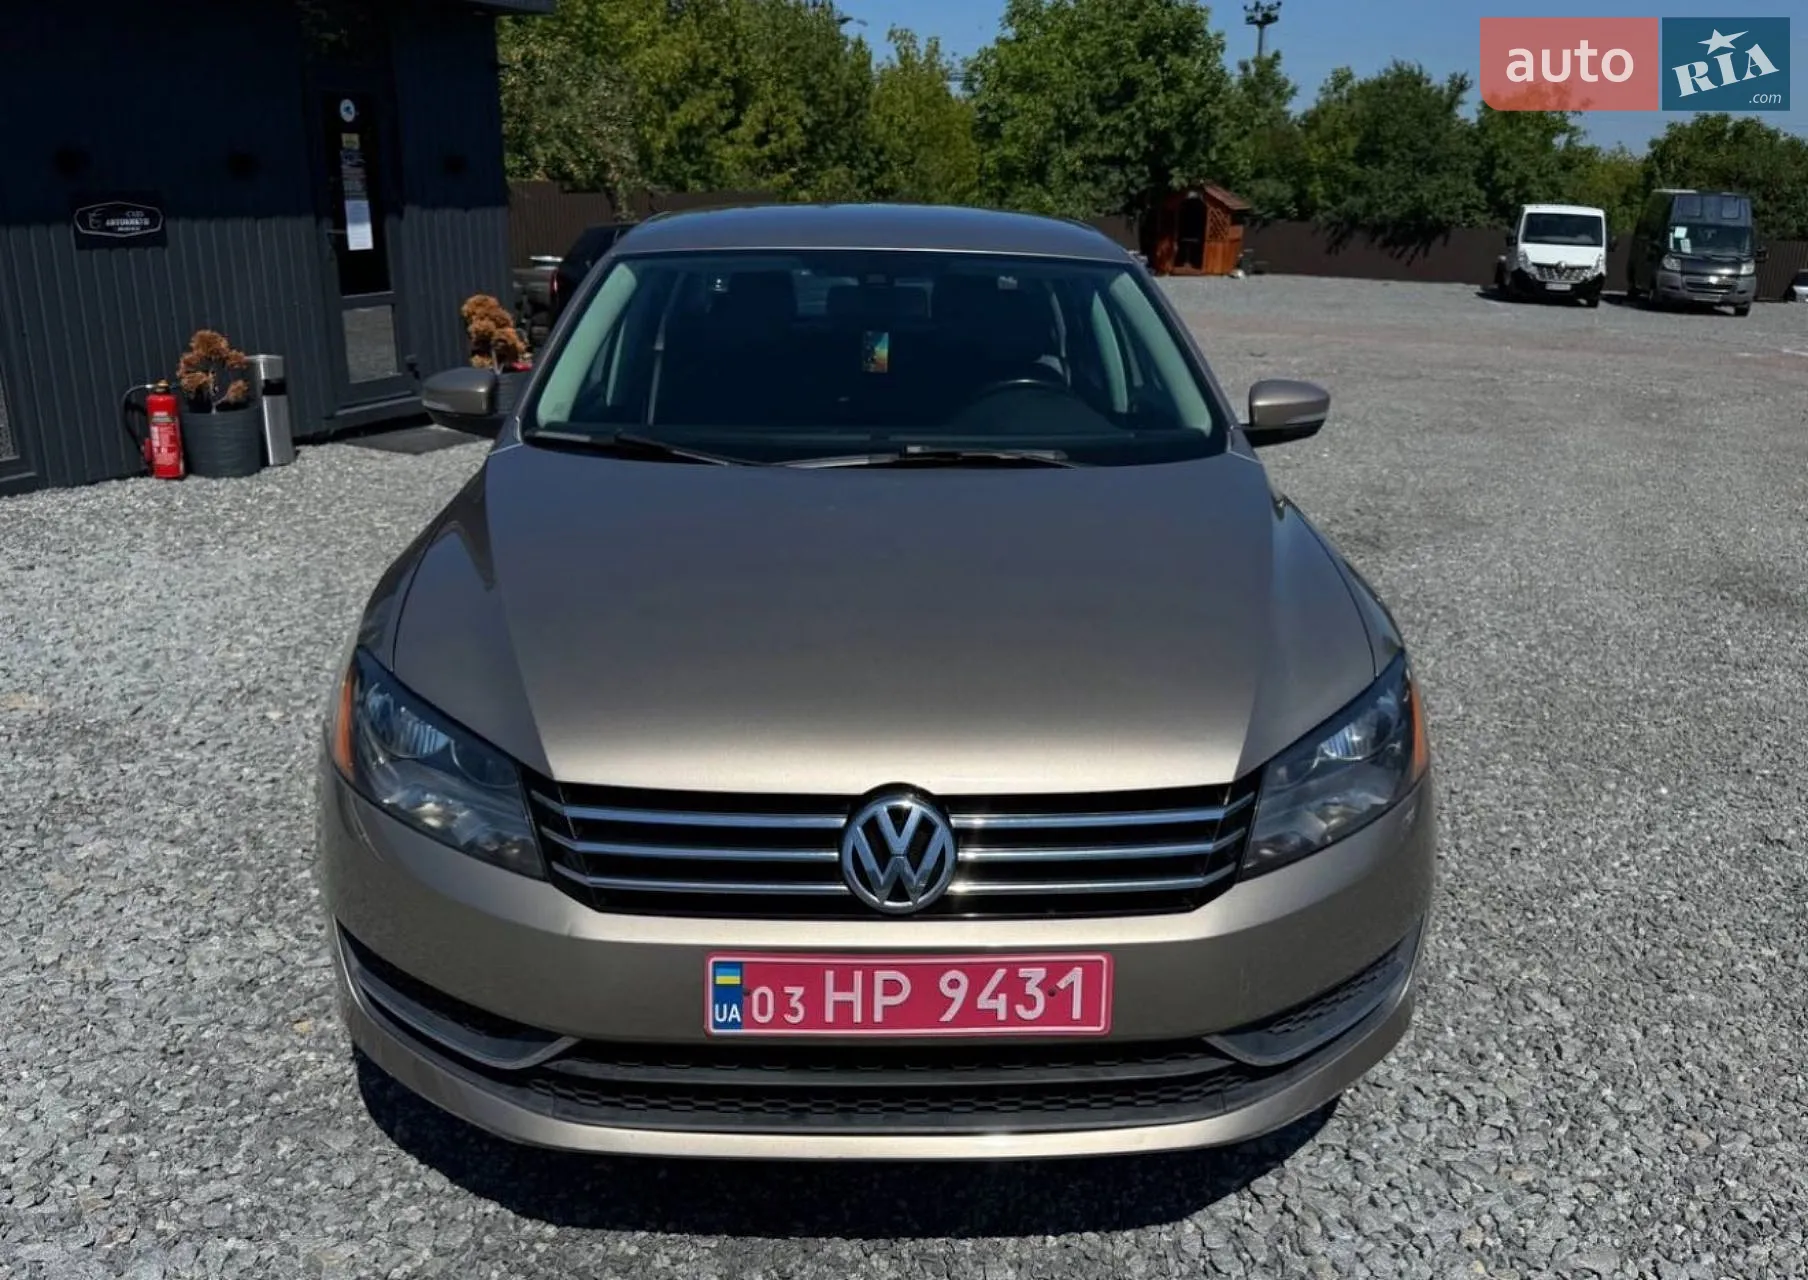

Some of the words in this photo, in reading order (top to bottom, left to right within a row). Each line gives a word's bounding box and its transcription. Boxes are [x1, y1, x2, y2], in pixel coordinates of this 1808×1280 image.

[714, 1003, 742, 1022] UA
[751, 986, 806, 1024] 03
[824, 969, 911, 1023] HP
[938, 966, 1083, 1022] 9431
